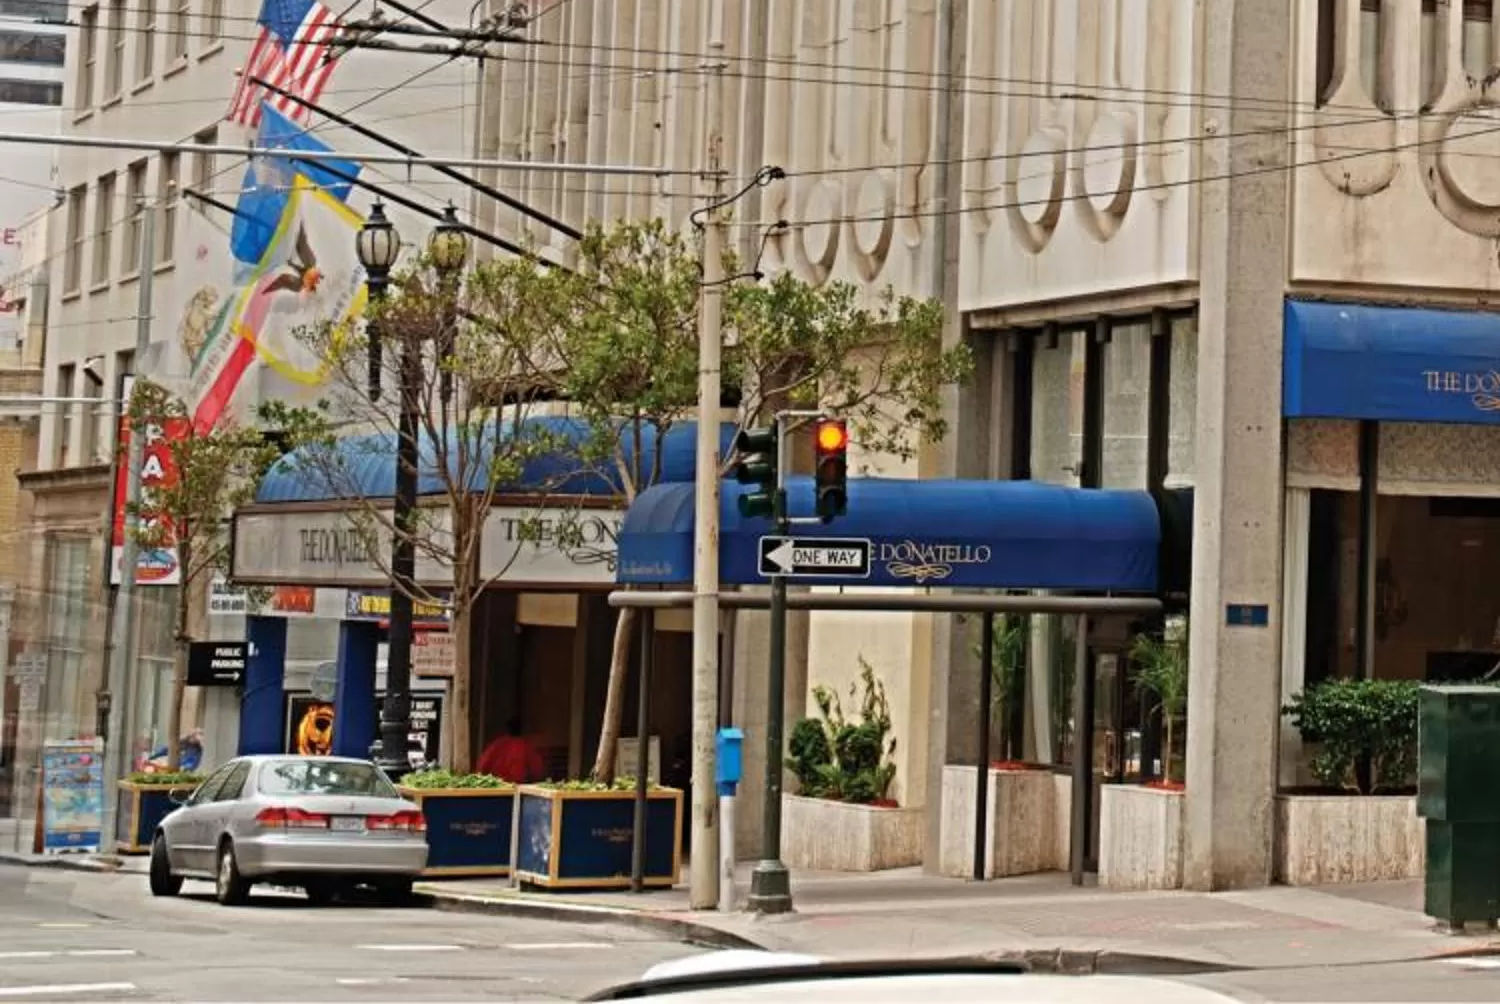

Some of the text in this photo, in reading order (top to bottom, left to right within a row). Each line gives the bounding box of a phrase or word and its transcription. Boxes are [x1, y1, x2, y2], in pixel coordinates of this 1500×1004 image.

[1421, 370, 1461, 391] THE
[793, 548, 821, 564] ONE
[827, 549, 857, 565] WAY
[880, 539, 992, 564] DONATELLO
